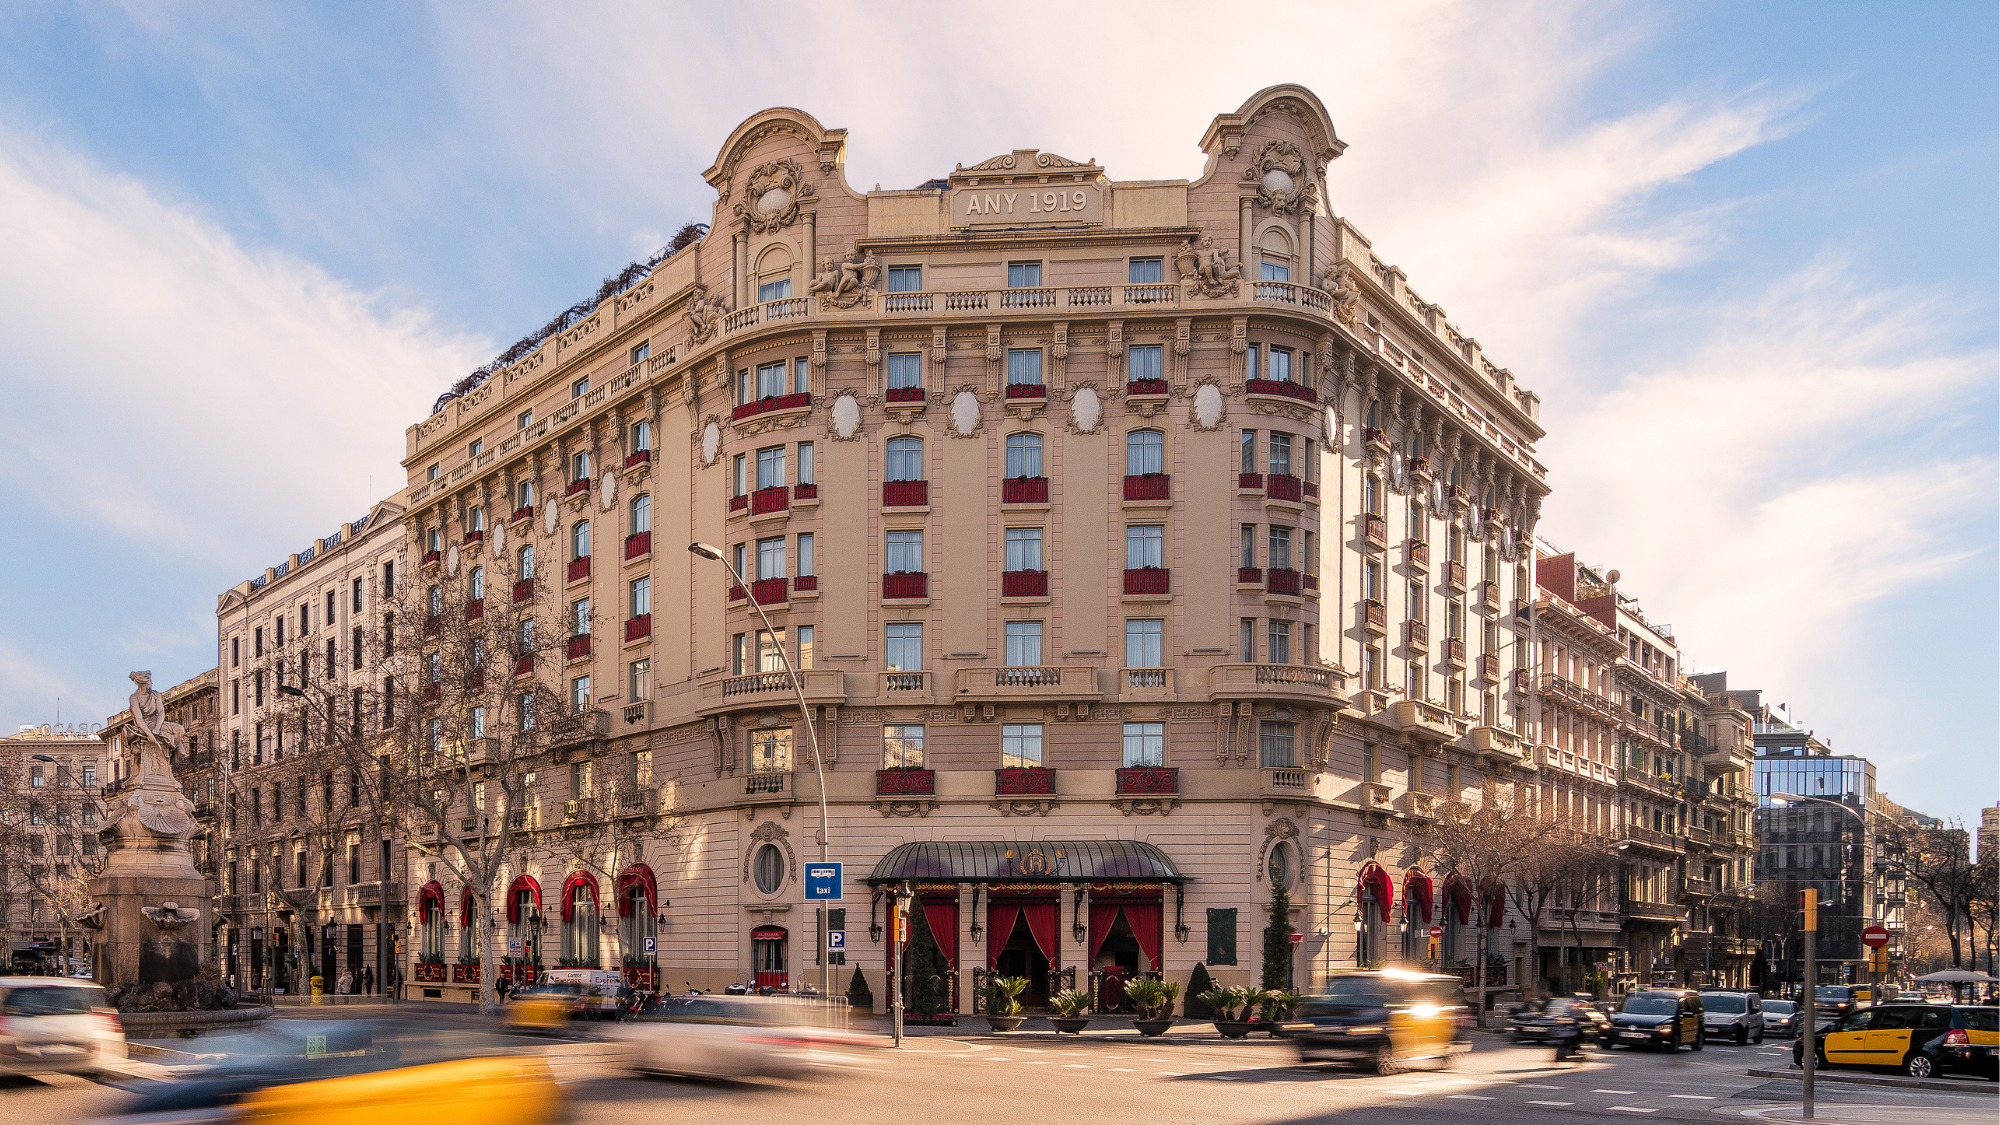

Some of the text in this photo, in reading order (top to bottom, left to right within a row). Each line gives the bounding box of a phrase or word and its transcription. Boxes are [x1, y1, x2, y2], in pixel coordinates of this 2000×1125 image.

[966, 190, 1087, 215] ANY 1919
[41, 723, 102, 736] OCASO
[646, 939, 653, 950] P
[831, 933, 842, 946] P
